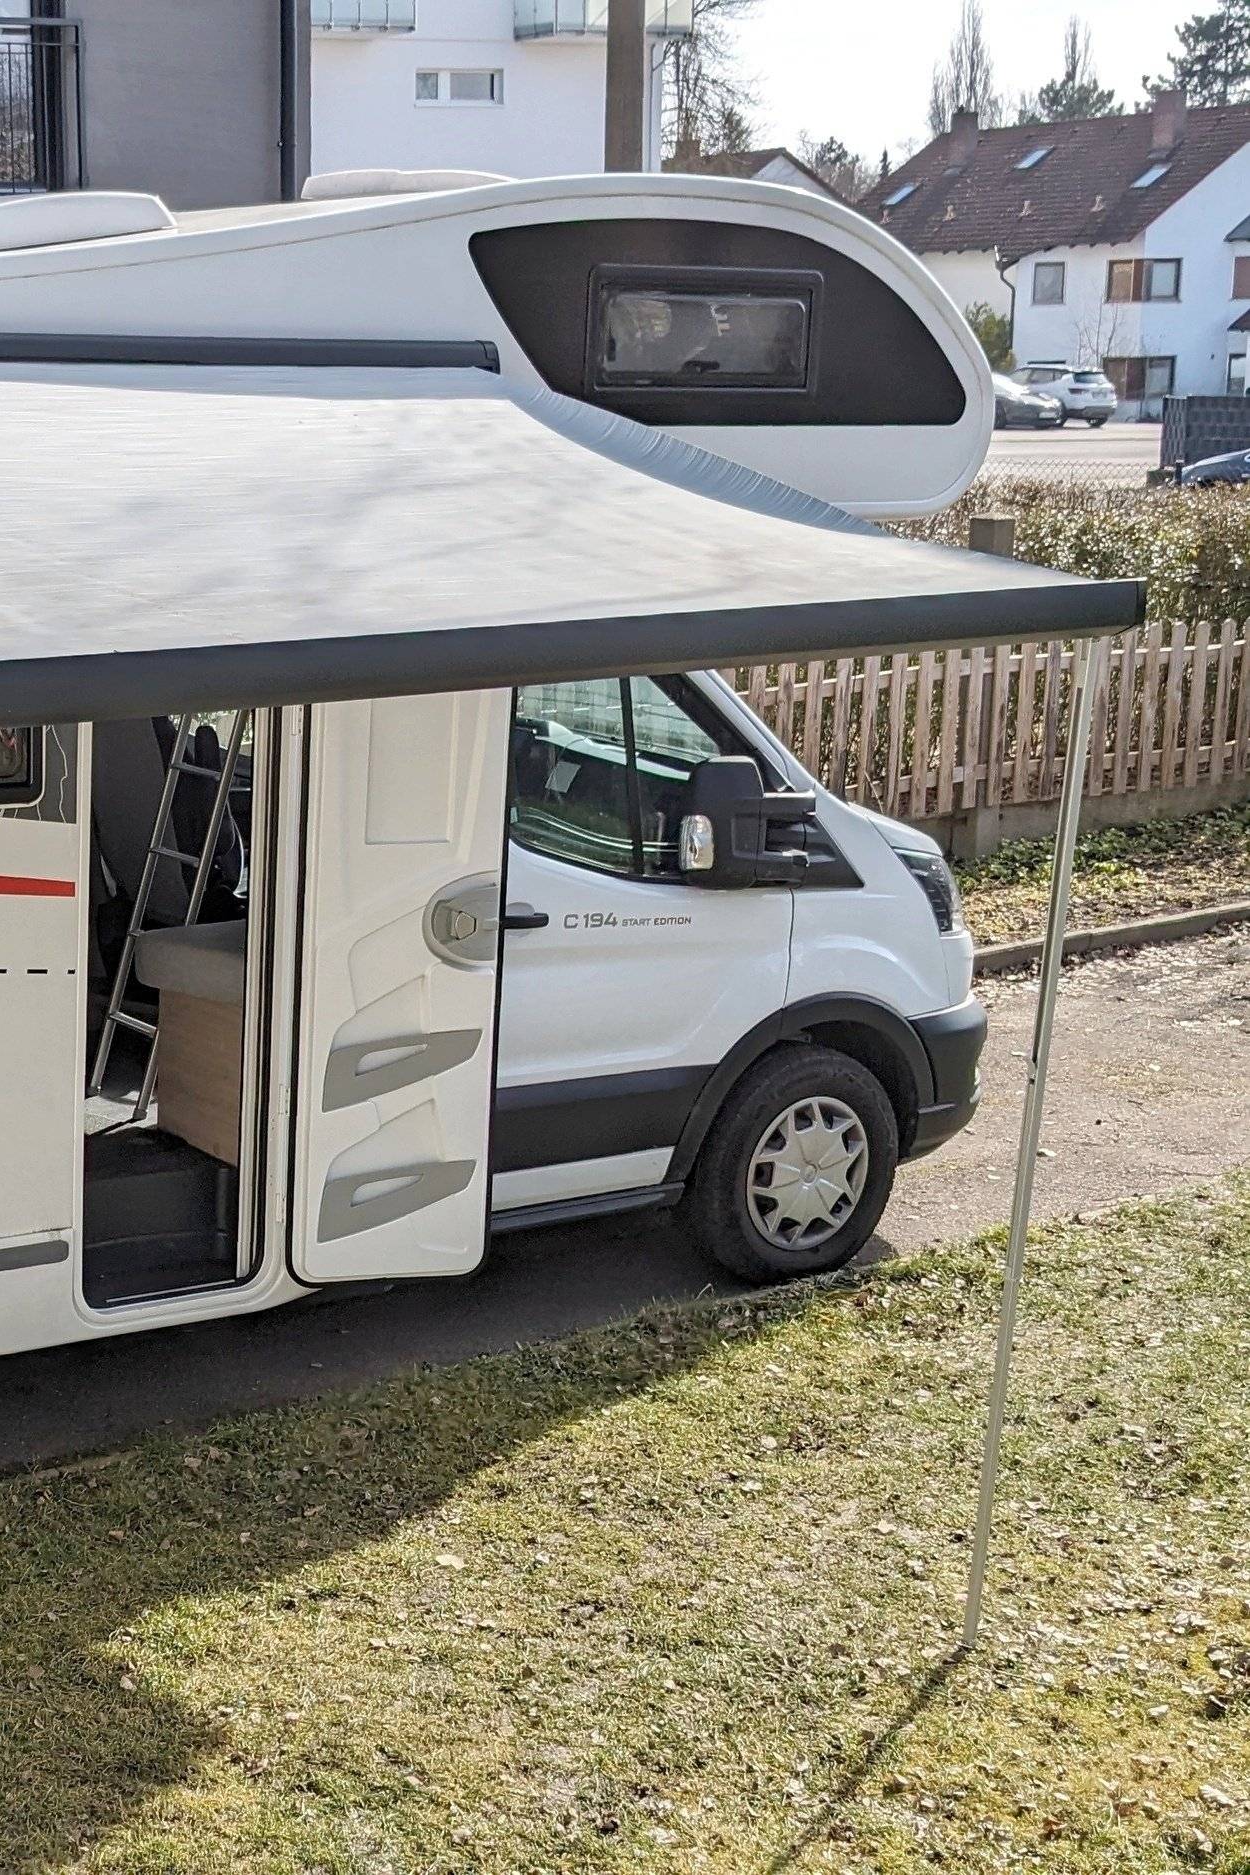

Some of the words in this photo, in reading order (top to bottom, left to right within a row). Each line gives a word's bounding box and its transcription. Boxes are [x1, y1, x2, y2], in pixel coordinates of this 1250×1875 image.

[563, 913, 579, 929] C
[583, 912, 618, 929] 194
[621, 917, 651, 927] START
[654, 916, 692, 926] EDITION
